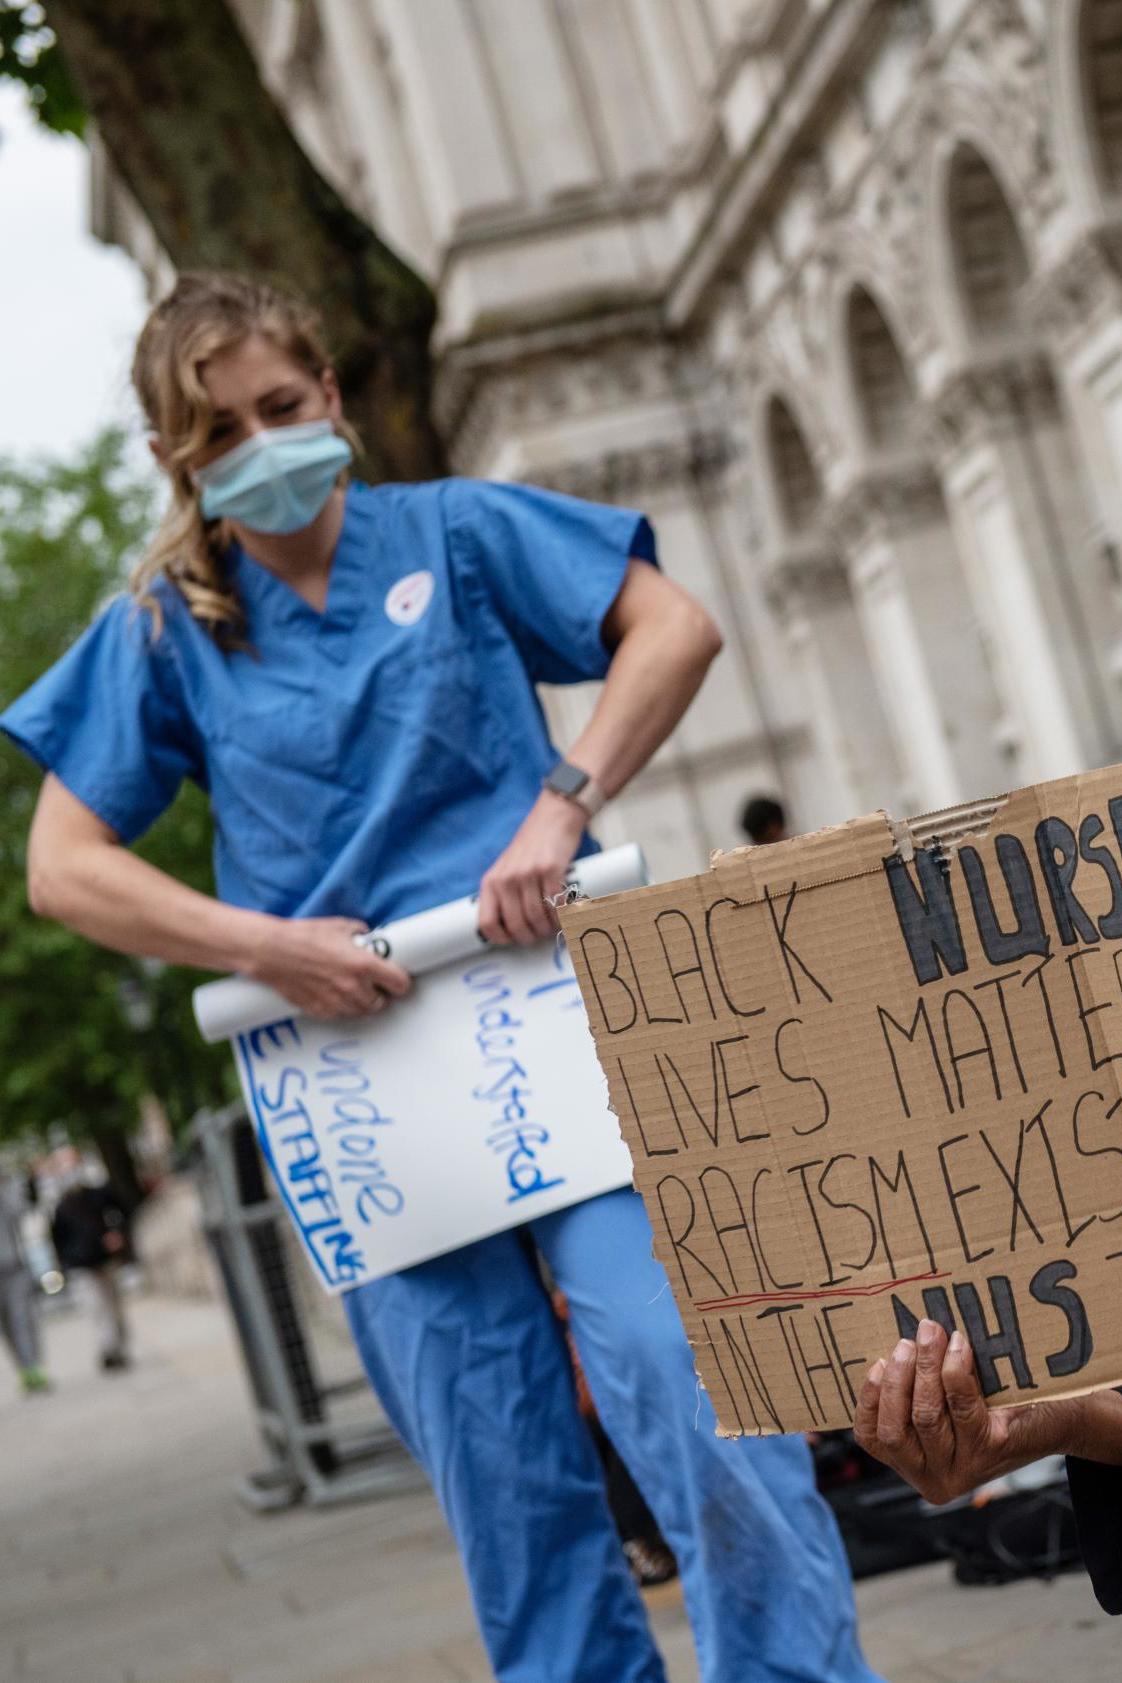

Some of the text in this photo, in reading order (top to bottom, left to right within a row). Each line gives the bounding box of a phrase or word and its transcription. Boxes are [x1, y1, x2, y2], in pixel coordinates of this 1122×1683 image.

[580, 881, 833, 1035] BLACK
[315, 1037, 405, 1226] undone
[616, 1017, 829, 1157] LIVES
[656, 1149, 938, 1298] RACISM
[701, 1312, 784, 1435] IN
[755, 1300, 867, 1427] THE
